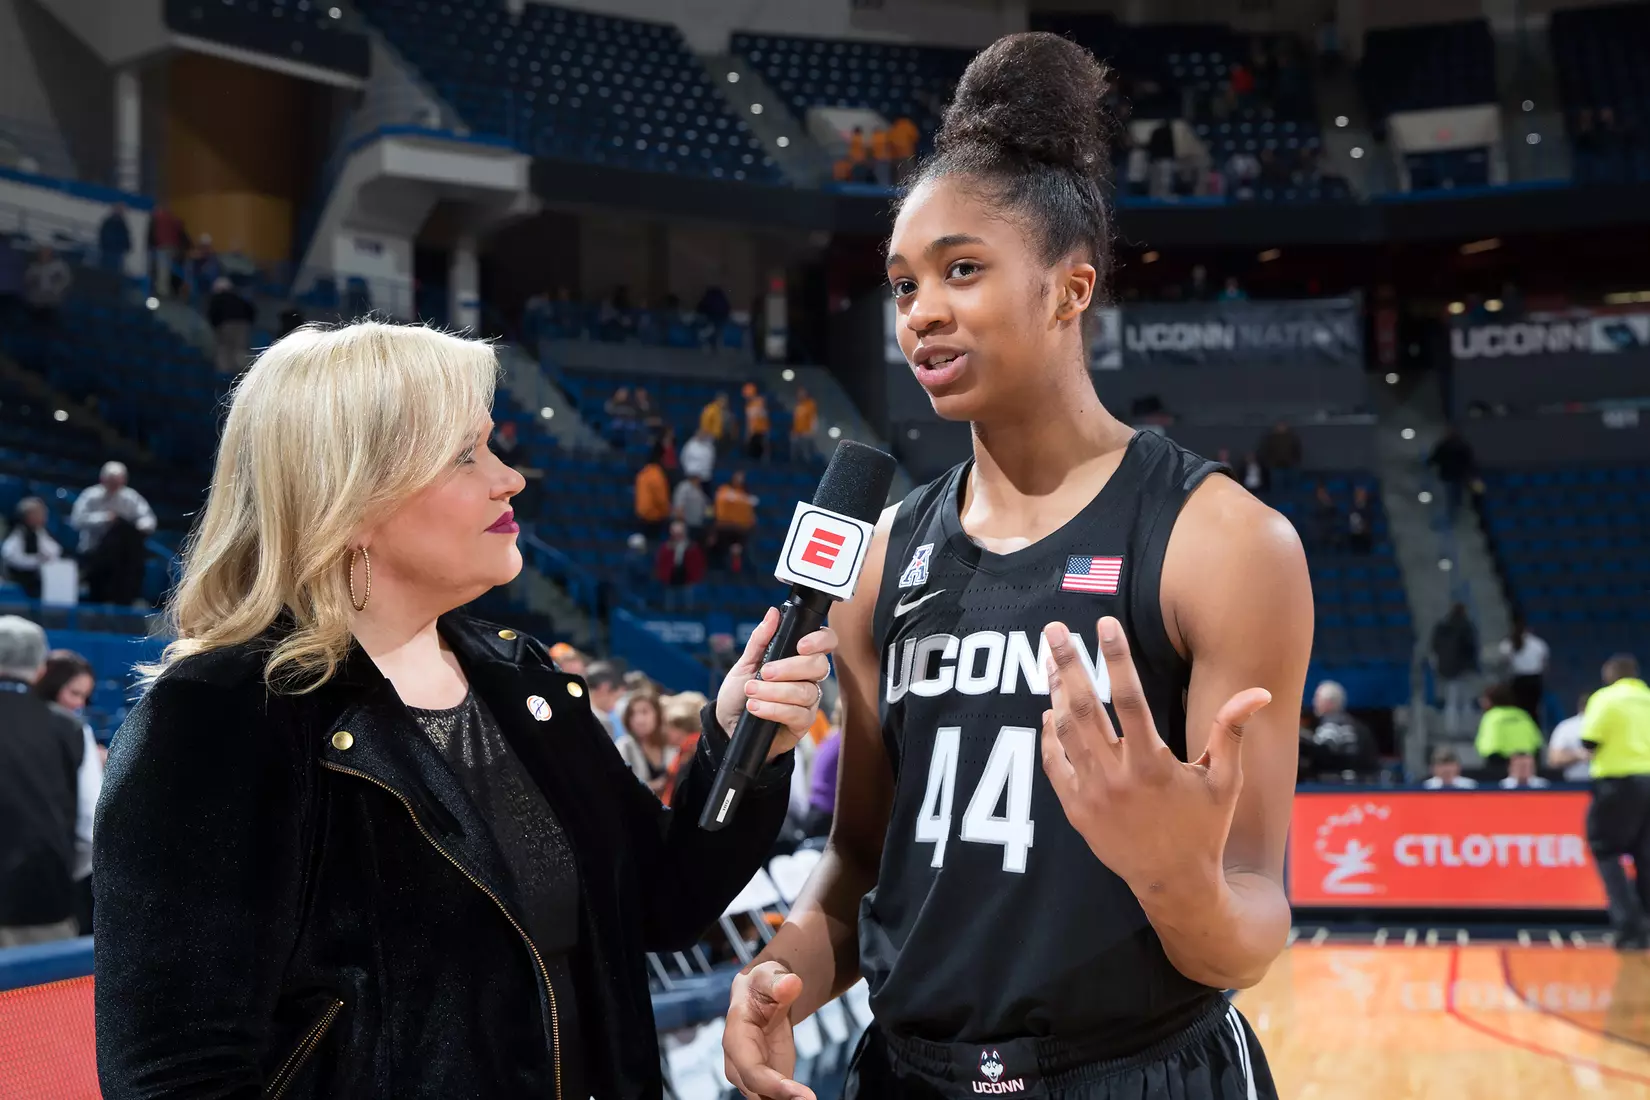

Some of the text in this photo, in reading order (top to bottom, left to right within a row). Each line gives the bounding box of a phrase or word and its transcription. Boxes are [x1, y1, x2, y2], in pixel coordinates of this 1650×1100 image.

[1126, 322, 1235, 352] UCONN
[1451, 322, 1592, 359] UCONN
[801, 527, 846, 570] E
[887, 630, 1112, 704] UCONN
[915, 726, 1037, 873] 44
[1393, 834, 1587, 867] CTLOTTER
[972, 1078, 1025, 1094] UCONN
